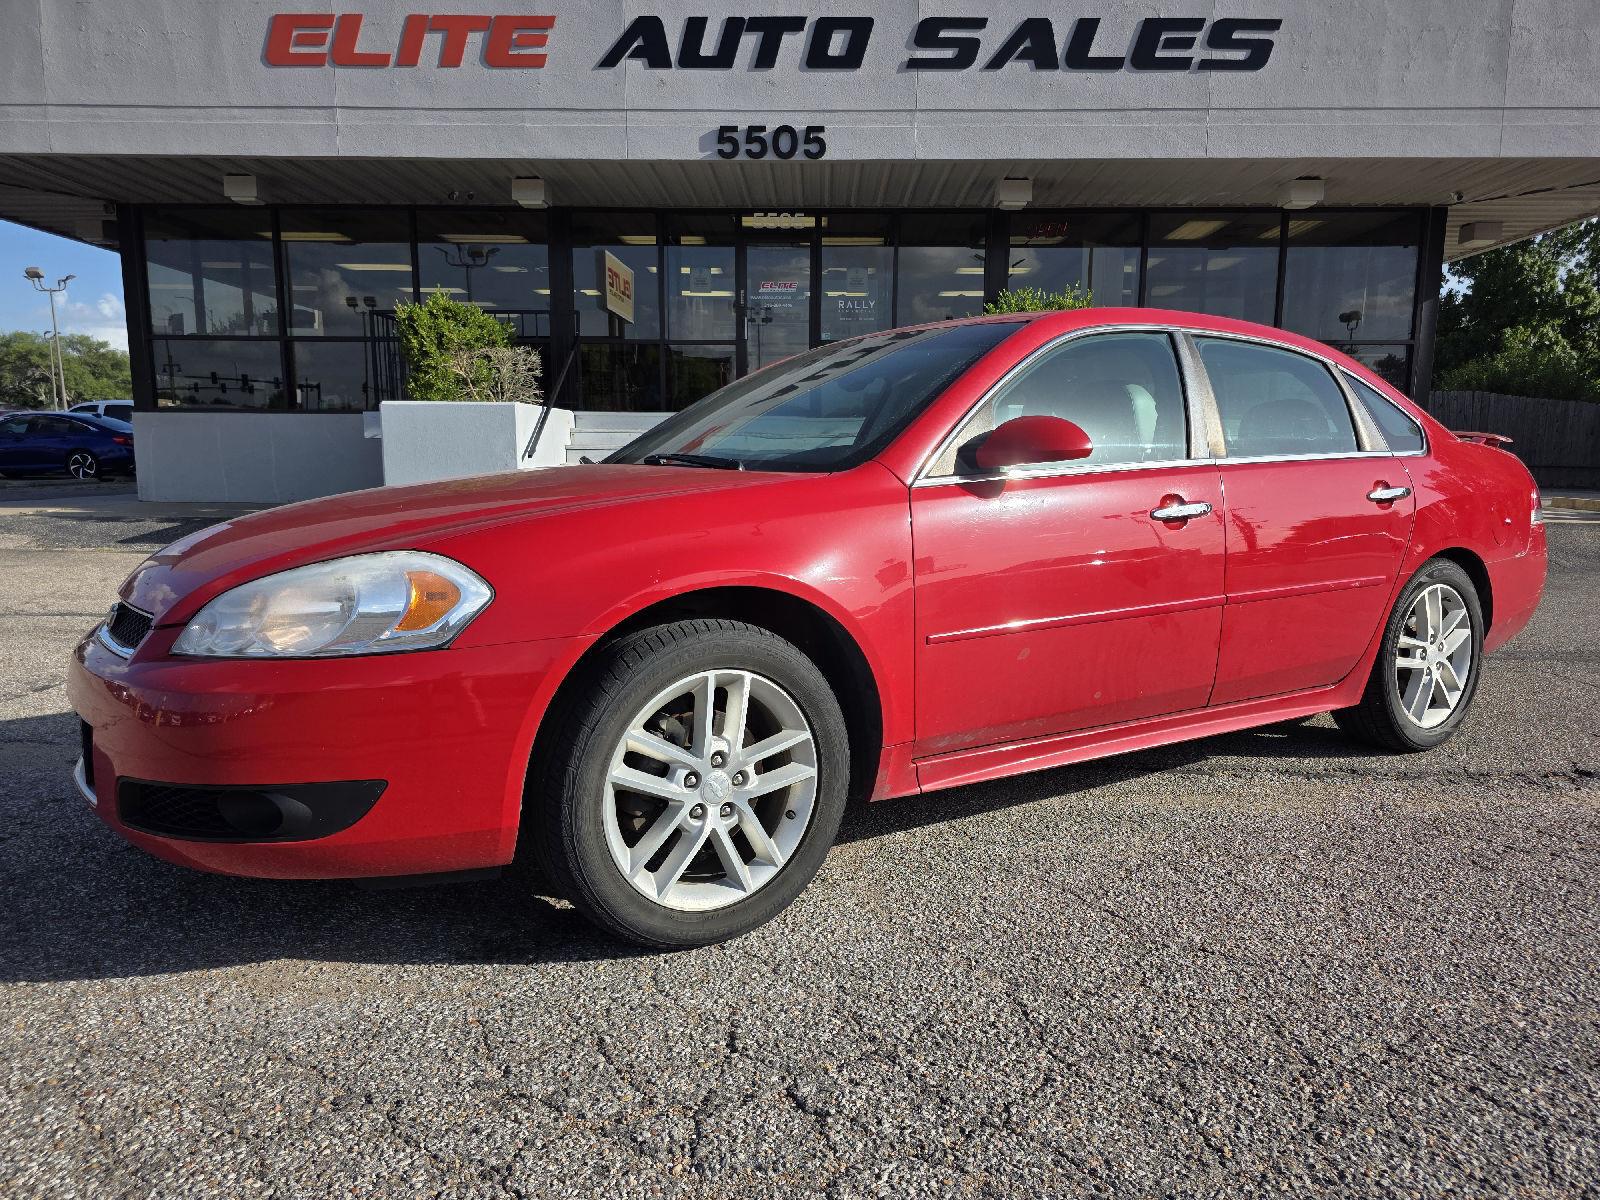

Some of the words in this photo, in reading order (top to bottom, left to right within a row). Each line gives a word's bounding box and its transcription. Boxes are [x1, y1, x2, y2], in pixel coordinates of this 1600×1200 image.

[264, 14, 557, 68] ELITE
[597, 16, 875, 70] AUTO
[907, 17, 1283, 71] SALES
[716, 125, 827, 160] 5505
[752, 212, 805, 230] 5505
[760, 281, 799, 290] ELITE
[838, 300, 876, 309] RALLY
